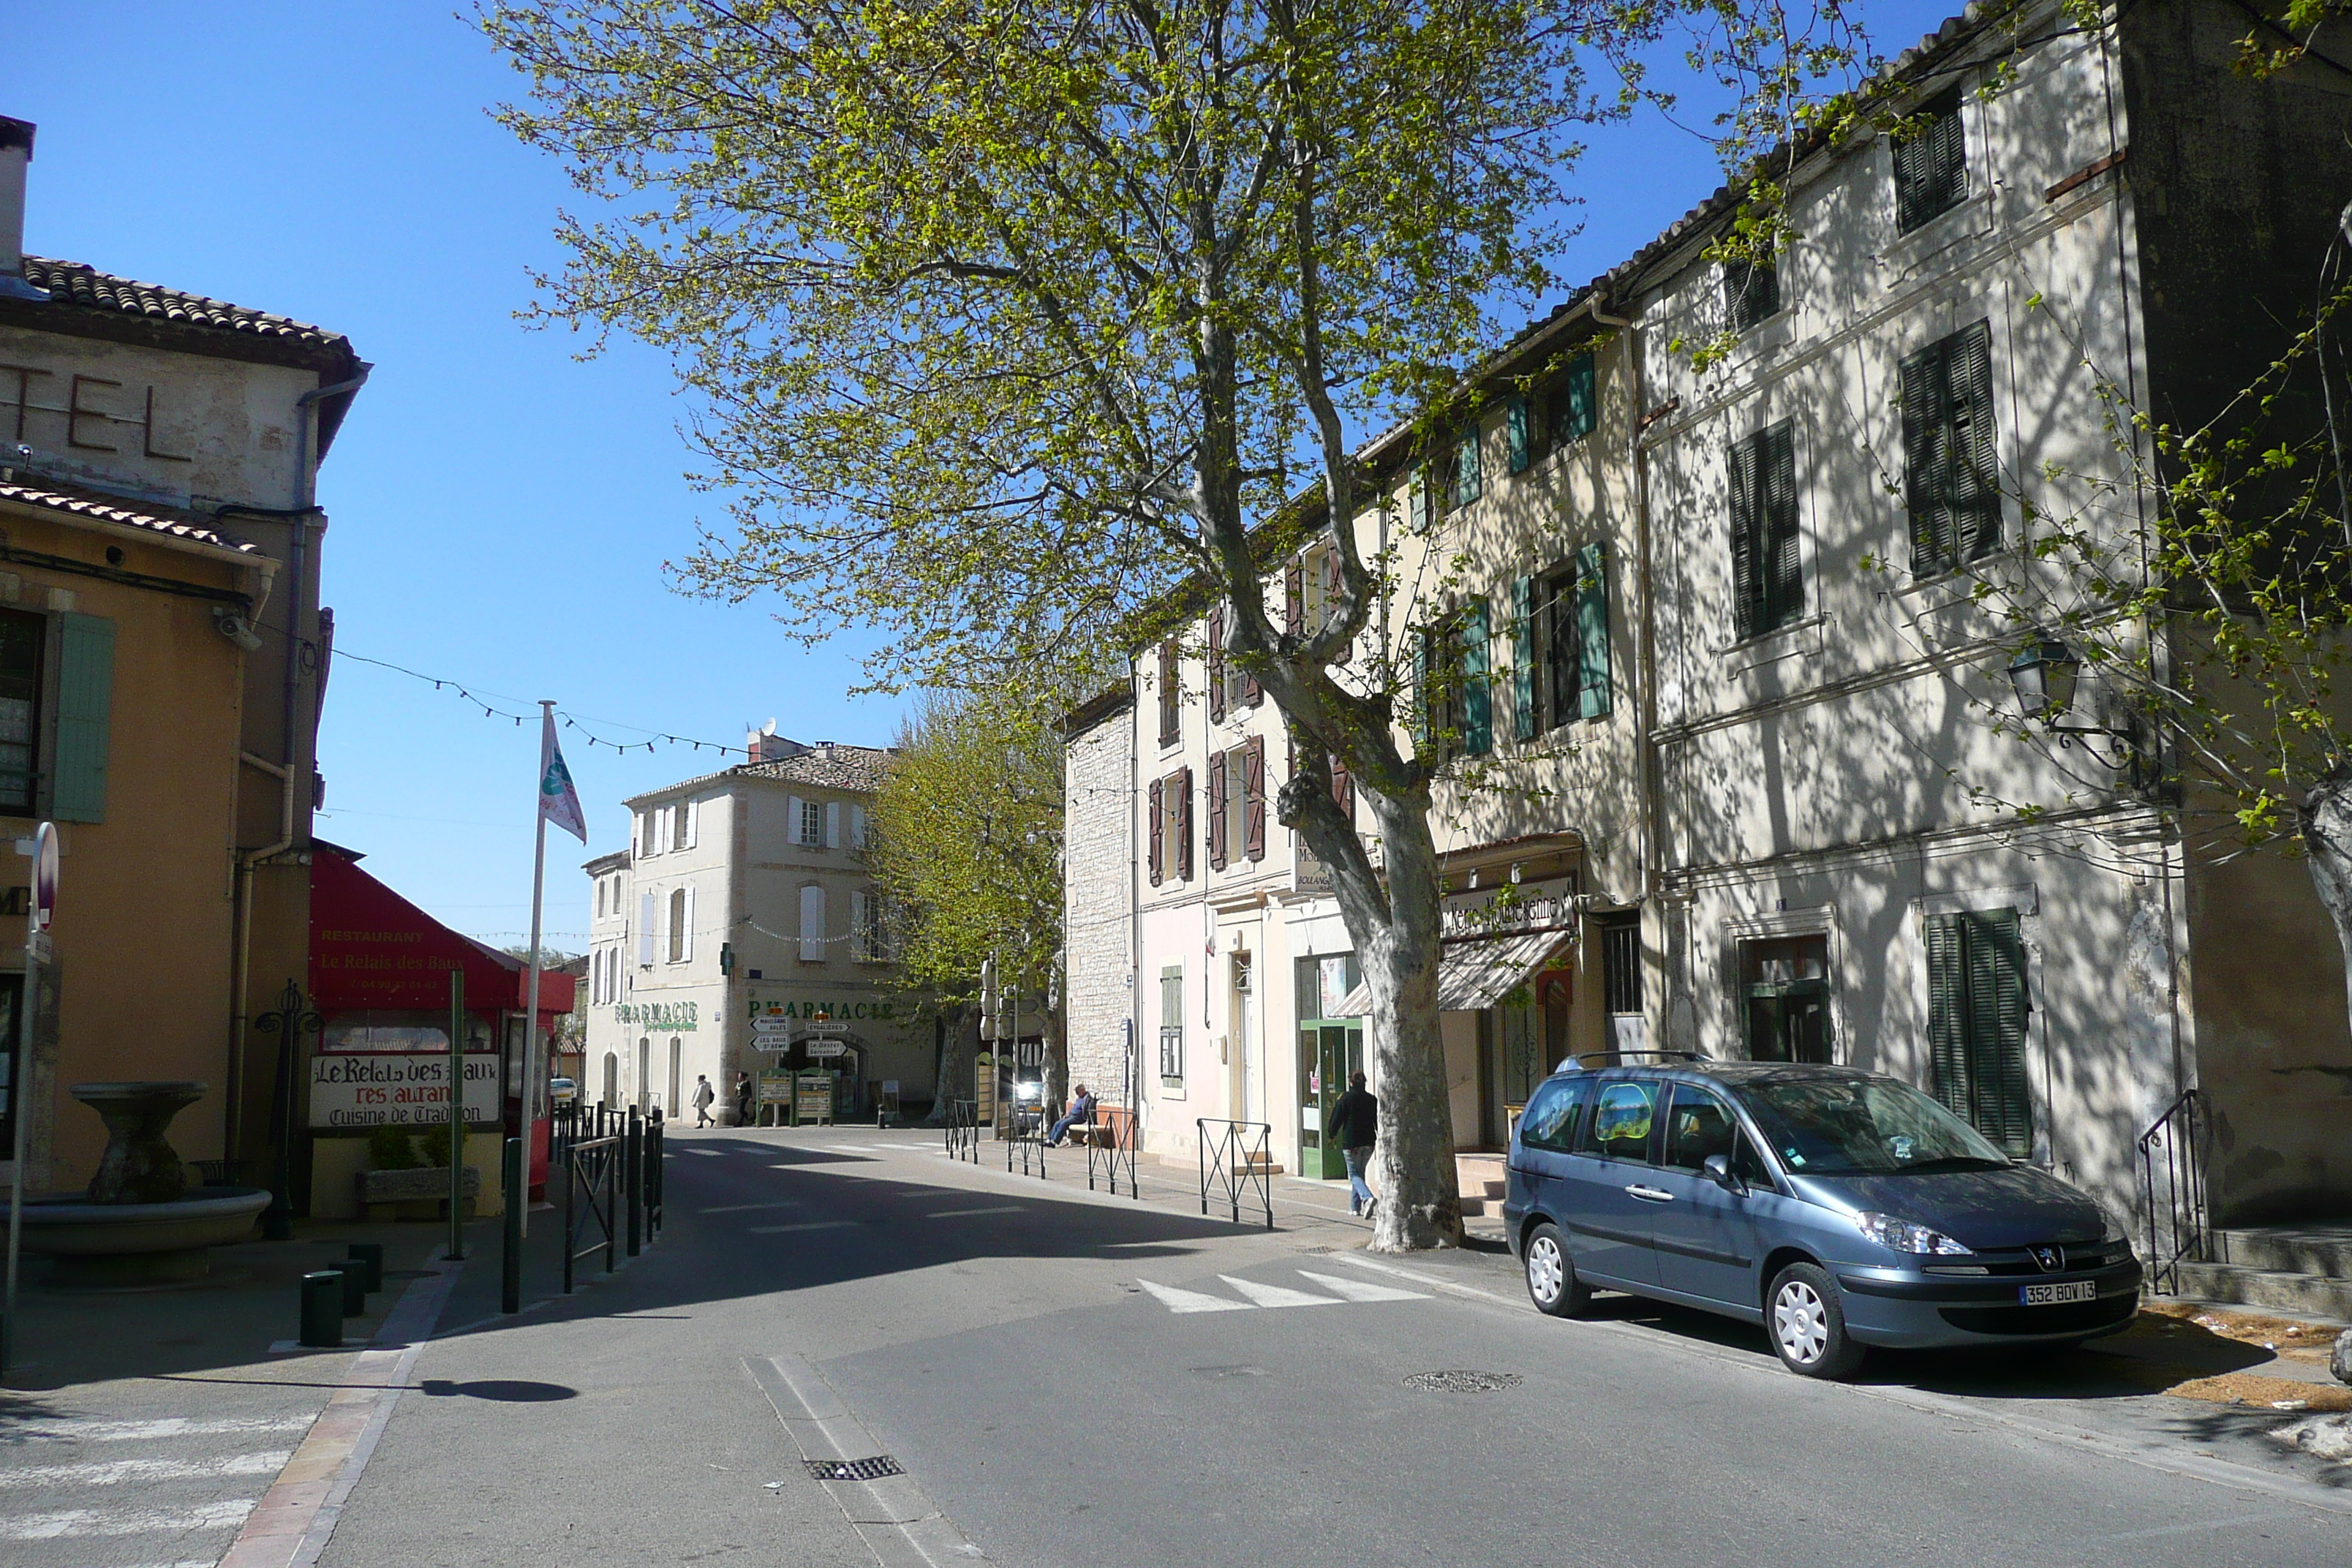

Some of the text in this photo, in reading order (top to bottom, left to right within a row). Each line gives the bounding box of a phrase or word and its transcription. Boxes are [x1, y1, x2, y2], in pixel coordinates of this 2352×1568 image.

[1298, 875, 1330, 886] BOULANG
[321, 930, 424, 943] RESTAURANT
[320, 954, 464, 970] Le Relais des Baux
[614, 1001, 698, 1023] PHARMACIE
[314, 1058, 341, 1084] Le
[445, 1063, 497, 1082] aux
[329, 1106, 481, 1126] Cuisine de Tradon
[2027, 1286, 2052, 1303] 352
[2081, 1282, 2095, 1298] 13
